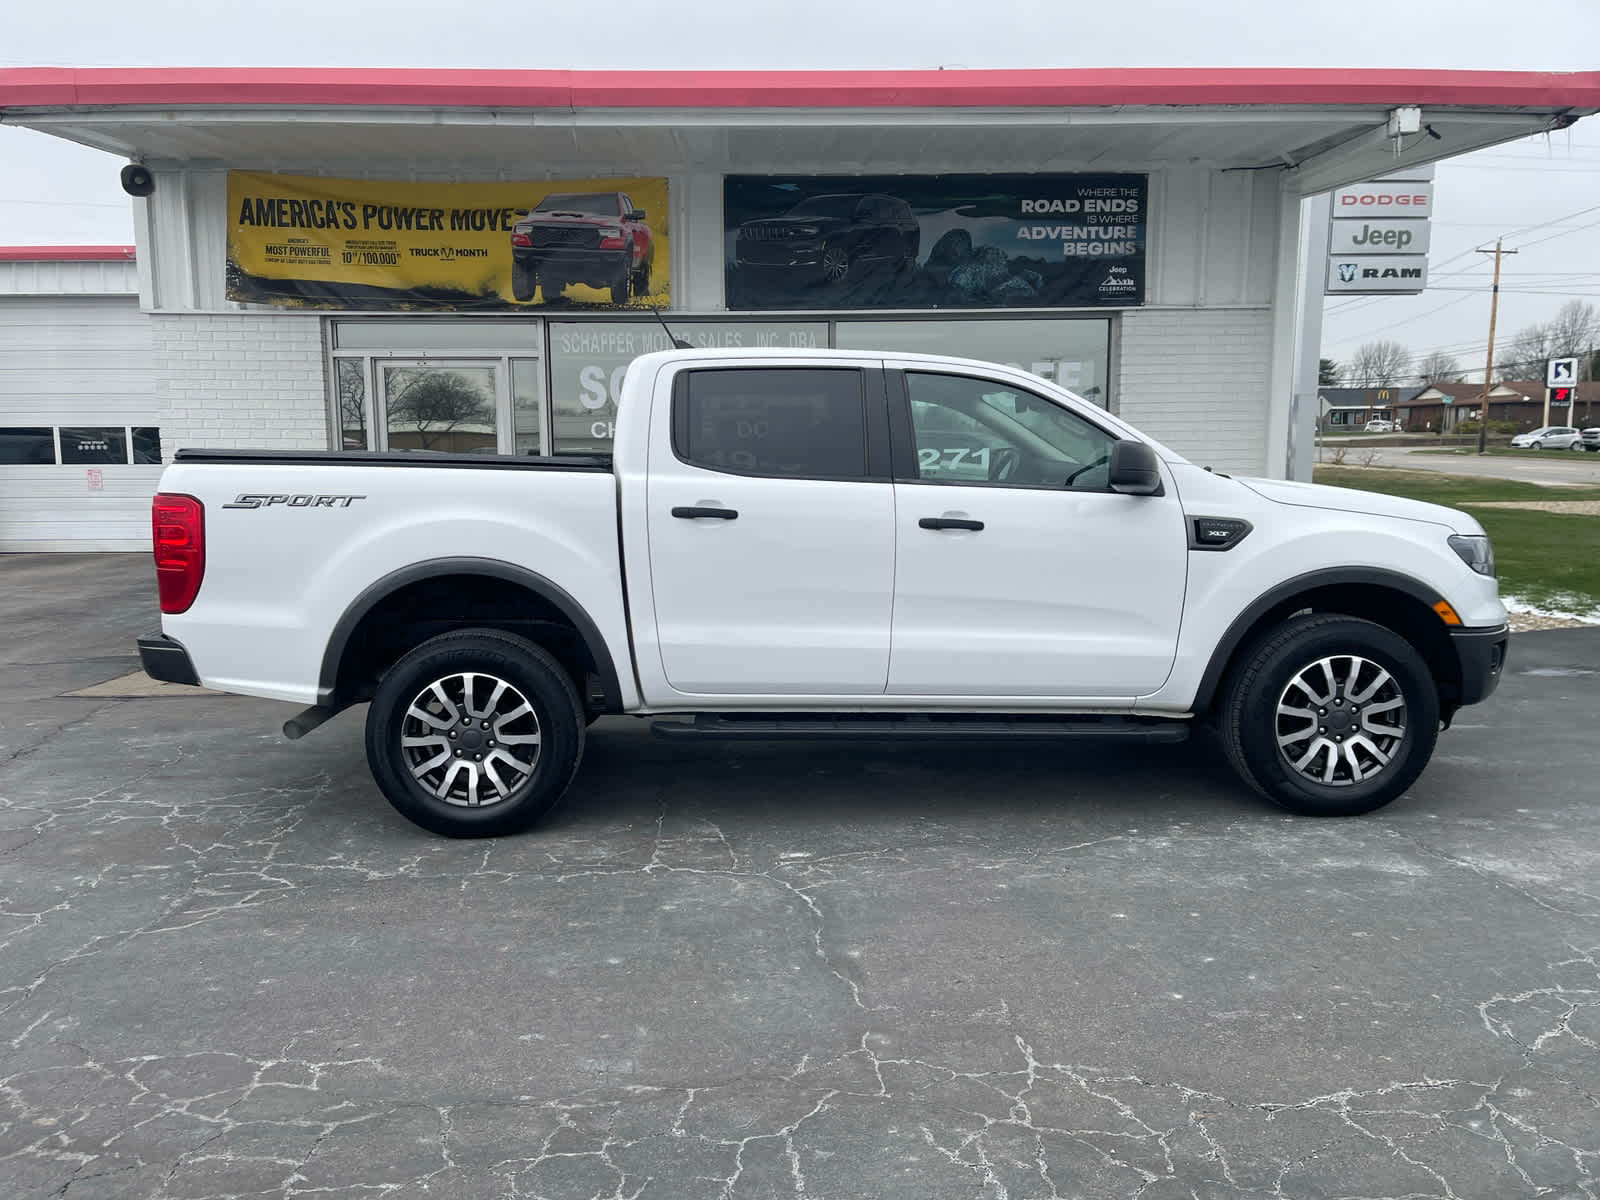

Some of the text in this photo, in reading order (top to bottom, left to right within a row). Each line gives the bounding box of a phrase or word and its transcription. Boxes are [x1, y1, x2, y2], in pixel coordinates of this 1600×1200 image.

[1077, 188, 1138, 197] WHERE THE
[1021, 199, 1139, 213] ROAD ENDS
[1341, 194, 1428, 206] DODGE
[239, 197, 358, 231] AMERICA'S
[362, 203, 445, 231] POWER
[1087, 215, 1139, 224] IS WHERE
[1016, 226, 1137, 239] ADVENTURE
[1352, 224, 1413, 250] Jeep
[265, 245, 330, 257] MOST POWERFUL
[408, 247, 488, 257] TRUCK MONTH
[1063, 241, 1137, 256] BEGINS
[1109, 265, 1127, 274] Jeep
[1362, 268, 1422, 279] RAM
[222, 493, 367, 509] SPORT
